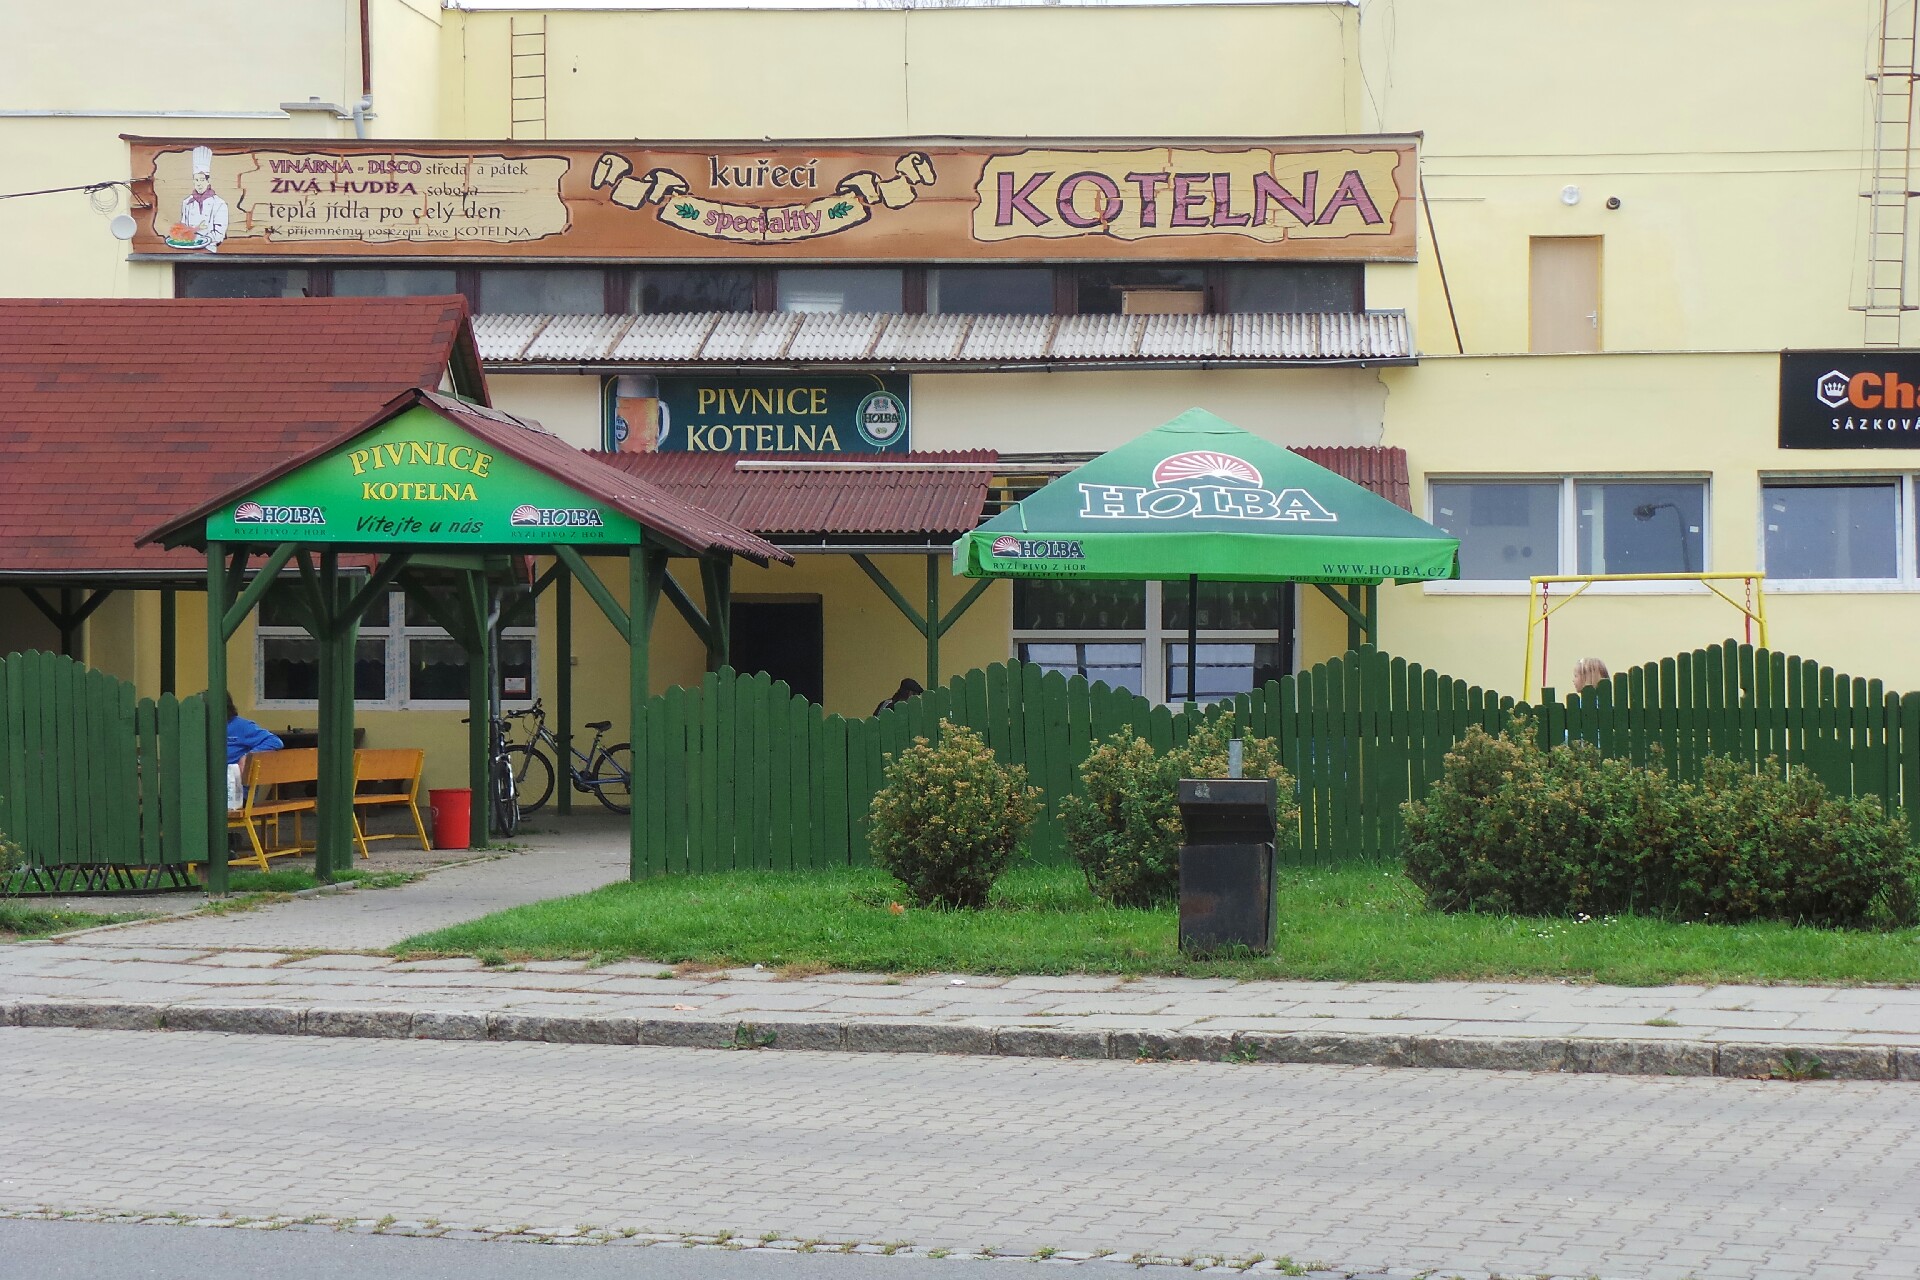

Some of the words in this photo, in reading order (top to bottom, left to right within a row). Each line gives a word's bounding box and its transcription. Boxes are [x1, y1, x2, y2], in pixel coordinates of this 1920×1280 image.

[269, 157, 354, 174] VINÁRNA
[368, 159, 422, 175] DISCO
[426, 163, 467, 175] středa
[477, 165, 484, 175] a
[491, 162, 529, 178] pátek
[708, 155, 818, 189] kuřecí
[270, 176, 321, 194] ŽIVÁ
[329, 180, 419, 195] HUDBA
[994, 170, 1385, 229] KOTELNA
[269, 200, 316, 222] teplá
[326, 200, 369, 223] jídla
[380, 206, 403, 222] po
[413, 201, 455, 224] celý
[464, 200, 501, 219] den
[703, 208, 822, 234] speciality
[697, 387, 828, 415] PIVNICE
[1847, 372, 1920, 409] Ch
[862, 412, 900, 424] HOLBA
[686, 424, 842, 451] KOTELNA
[347, 440, 493, 479] PIVNICE
[362, 481, 479, 501] KOTELNA
[1078, 482, 1338, 522] HOLBA
[260, 506, 326, 525] HOLBA
[356, 515, 423, 537] Vítejte
[429, 521, 442, 533] u
[448, 517, 484, 534] nás
[537, 508, 604, 527] HOLBA
[1018, 540, 1086, 559] HOLBA
[993, 561, 1018, 570] RYZÍ
[1022, 563, 1048, 571] PIVO
[1063, 563, 1087, 571] HOR
[1322, 564, 1446, 578] WWW.HOLBA.CZ
